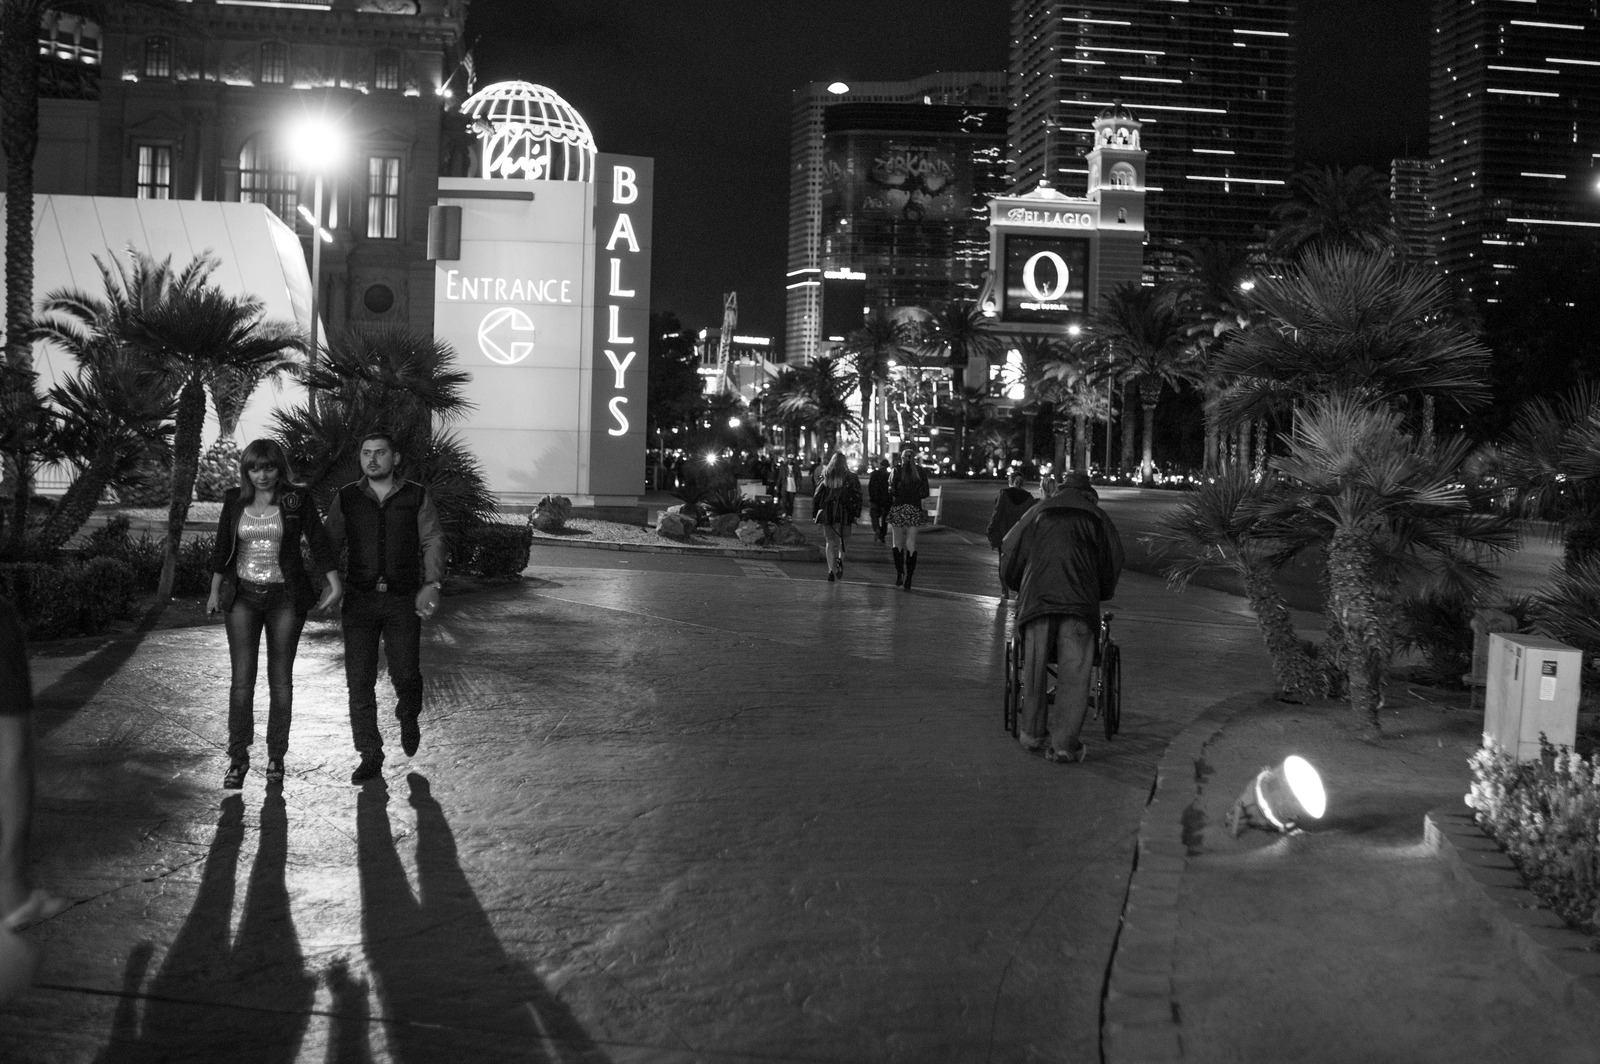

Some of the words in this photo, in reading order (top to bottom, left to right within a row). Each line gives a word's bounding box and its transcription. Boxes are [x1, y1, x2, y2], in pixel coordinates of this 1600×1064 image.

[1002, 207, 1092, 227] BELLAGIO
[604, 165, 640, 436] BALLYS
[1022, 250, 1070, 301] O
